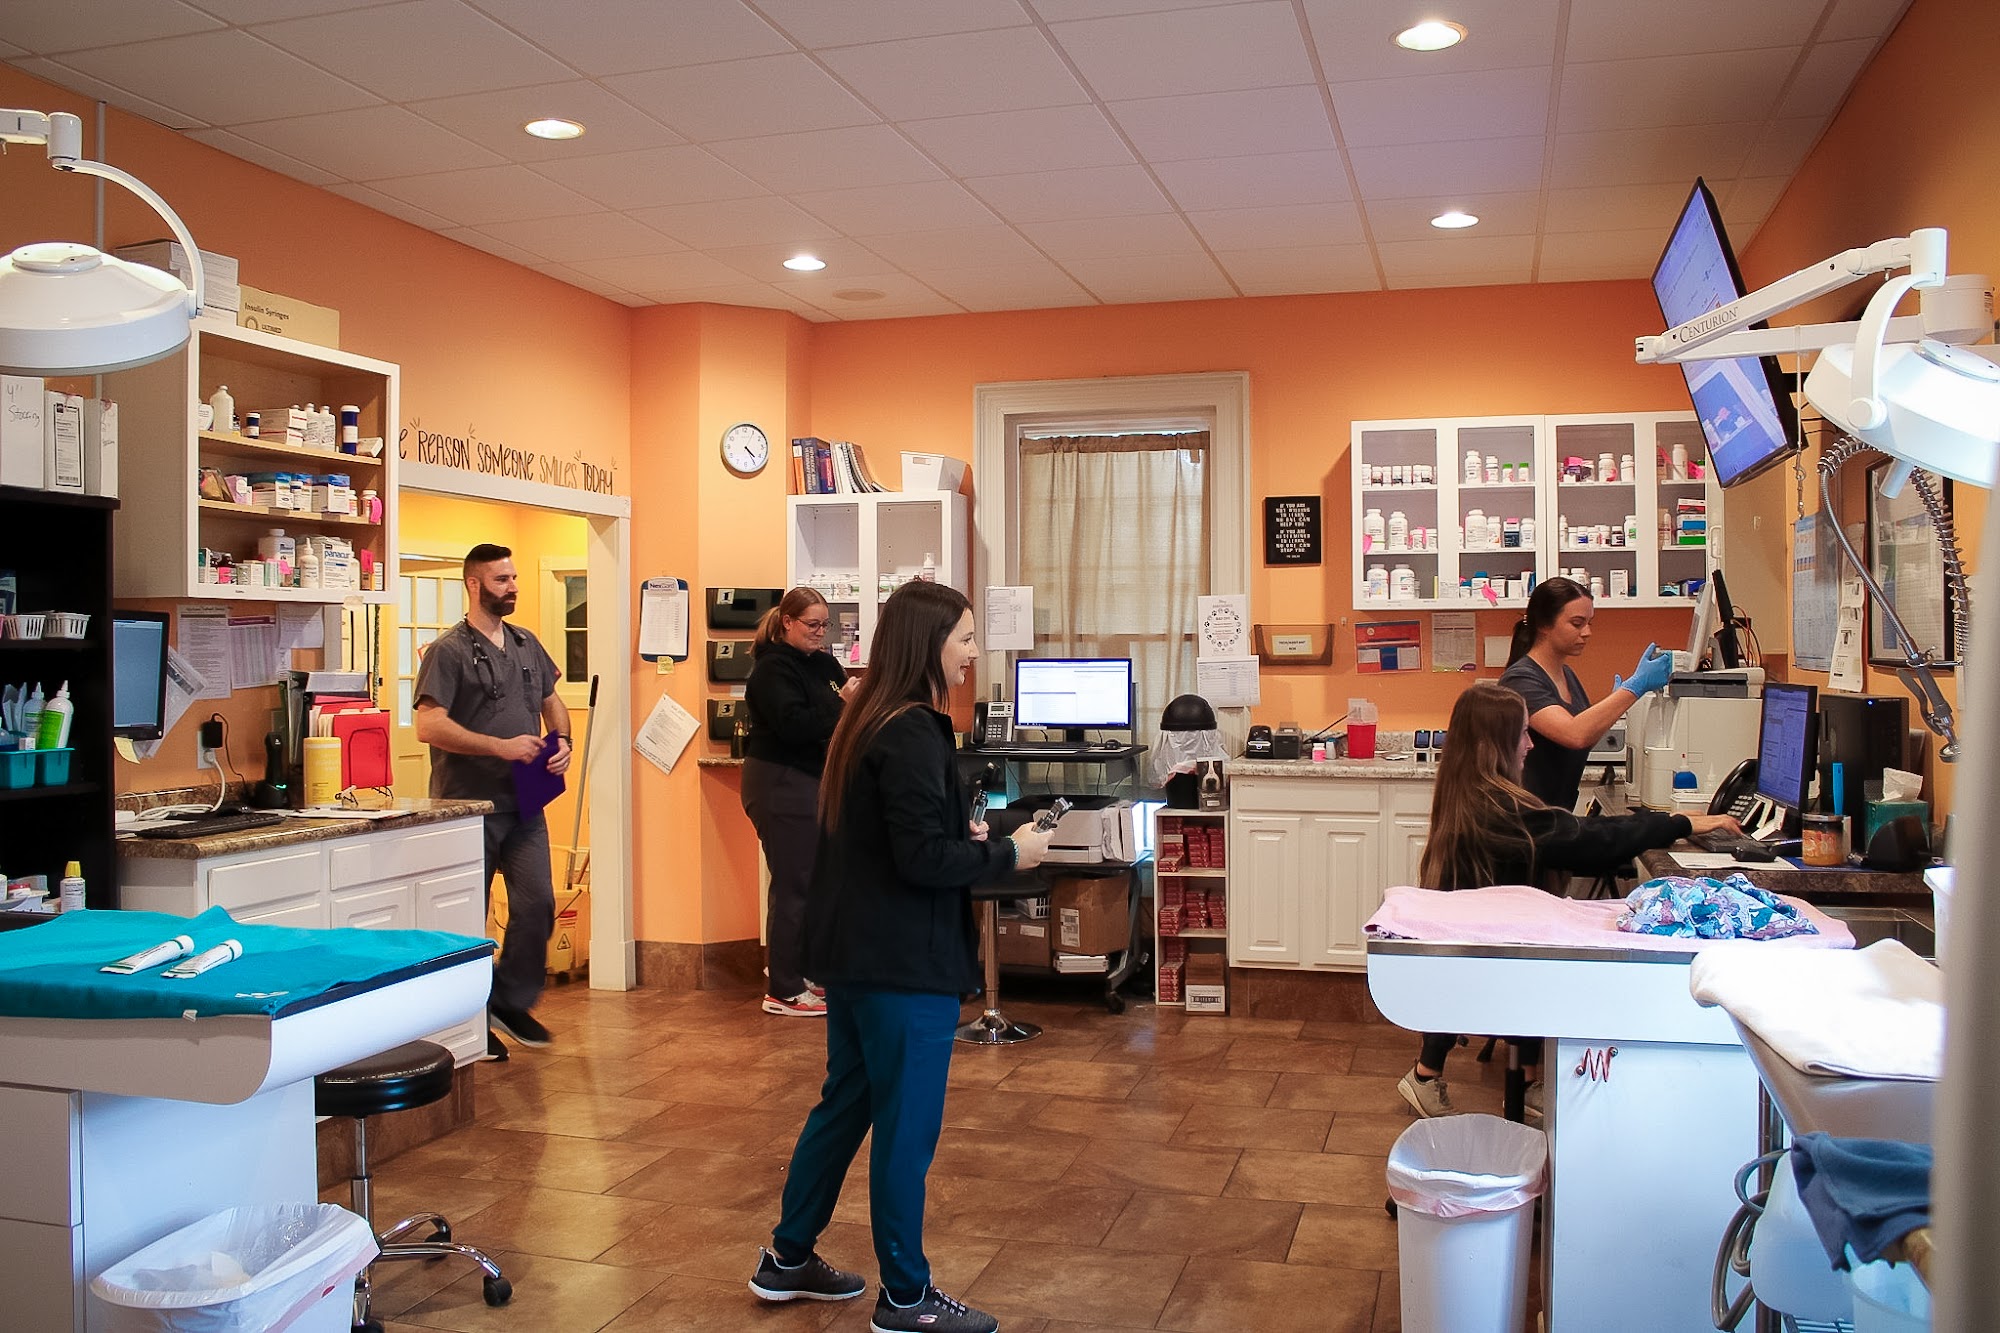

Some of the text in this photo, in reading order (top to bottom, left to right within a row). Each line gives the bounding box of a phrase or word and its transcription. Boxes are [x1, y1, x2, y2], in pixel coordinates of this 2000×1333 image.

[244, 302, 290, 321] Insulin Syringes
[1680, 308, 1737, 343] CENTURION
[582, 462, 613, 496] TODAY
[324, 550, 350, 560] panacur
[722, 592, 730, 602] 1
[720, 646, 730, 655] 2
[722, 704, 731, 714] 3
